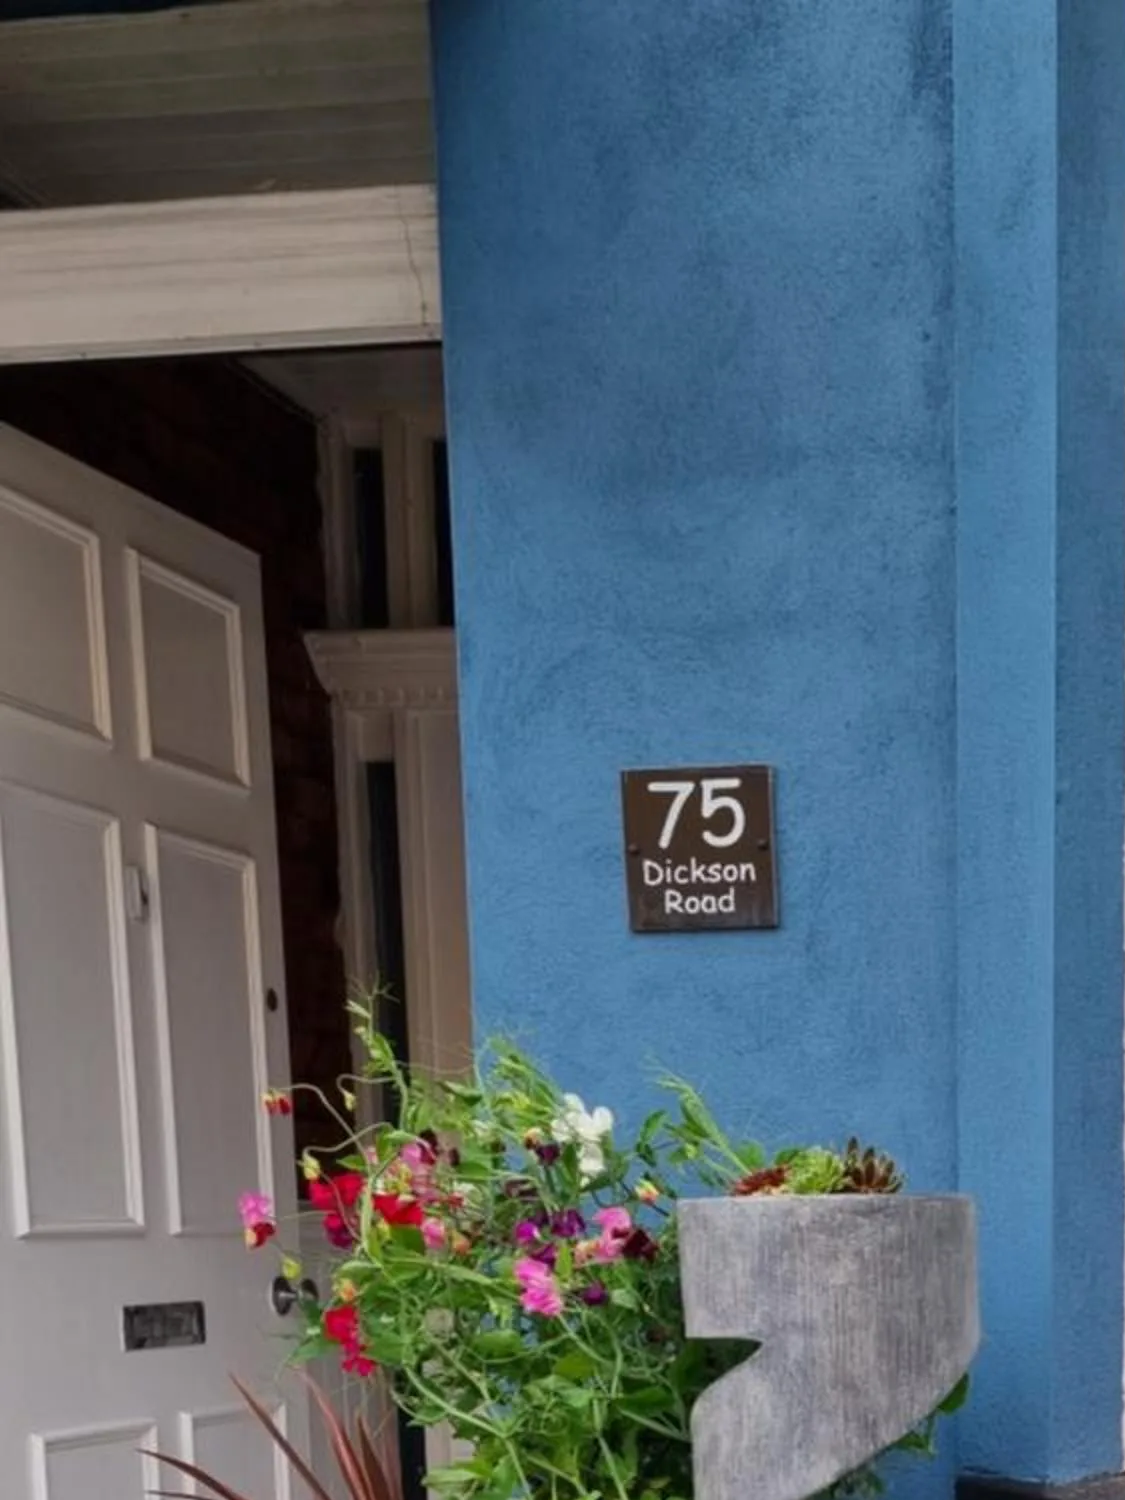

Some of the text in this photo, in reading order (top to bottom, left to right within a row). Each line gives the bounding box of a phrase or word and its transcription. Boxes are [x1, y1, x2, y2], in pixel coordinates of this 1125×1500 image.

[647, 777, 746, 849] 75
[642, 857, 757, 886] Dickson
[665, 887, 737, 914] Road
